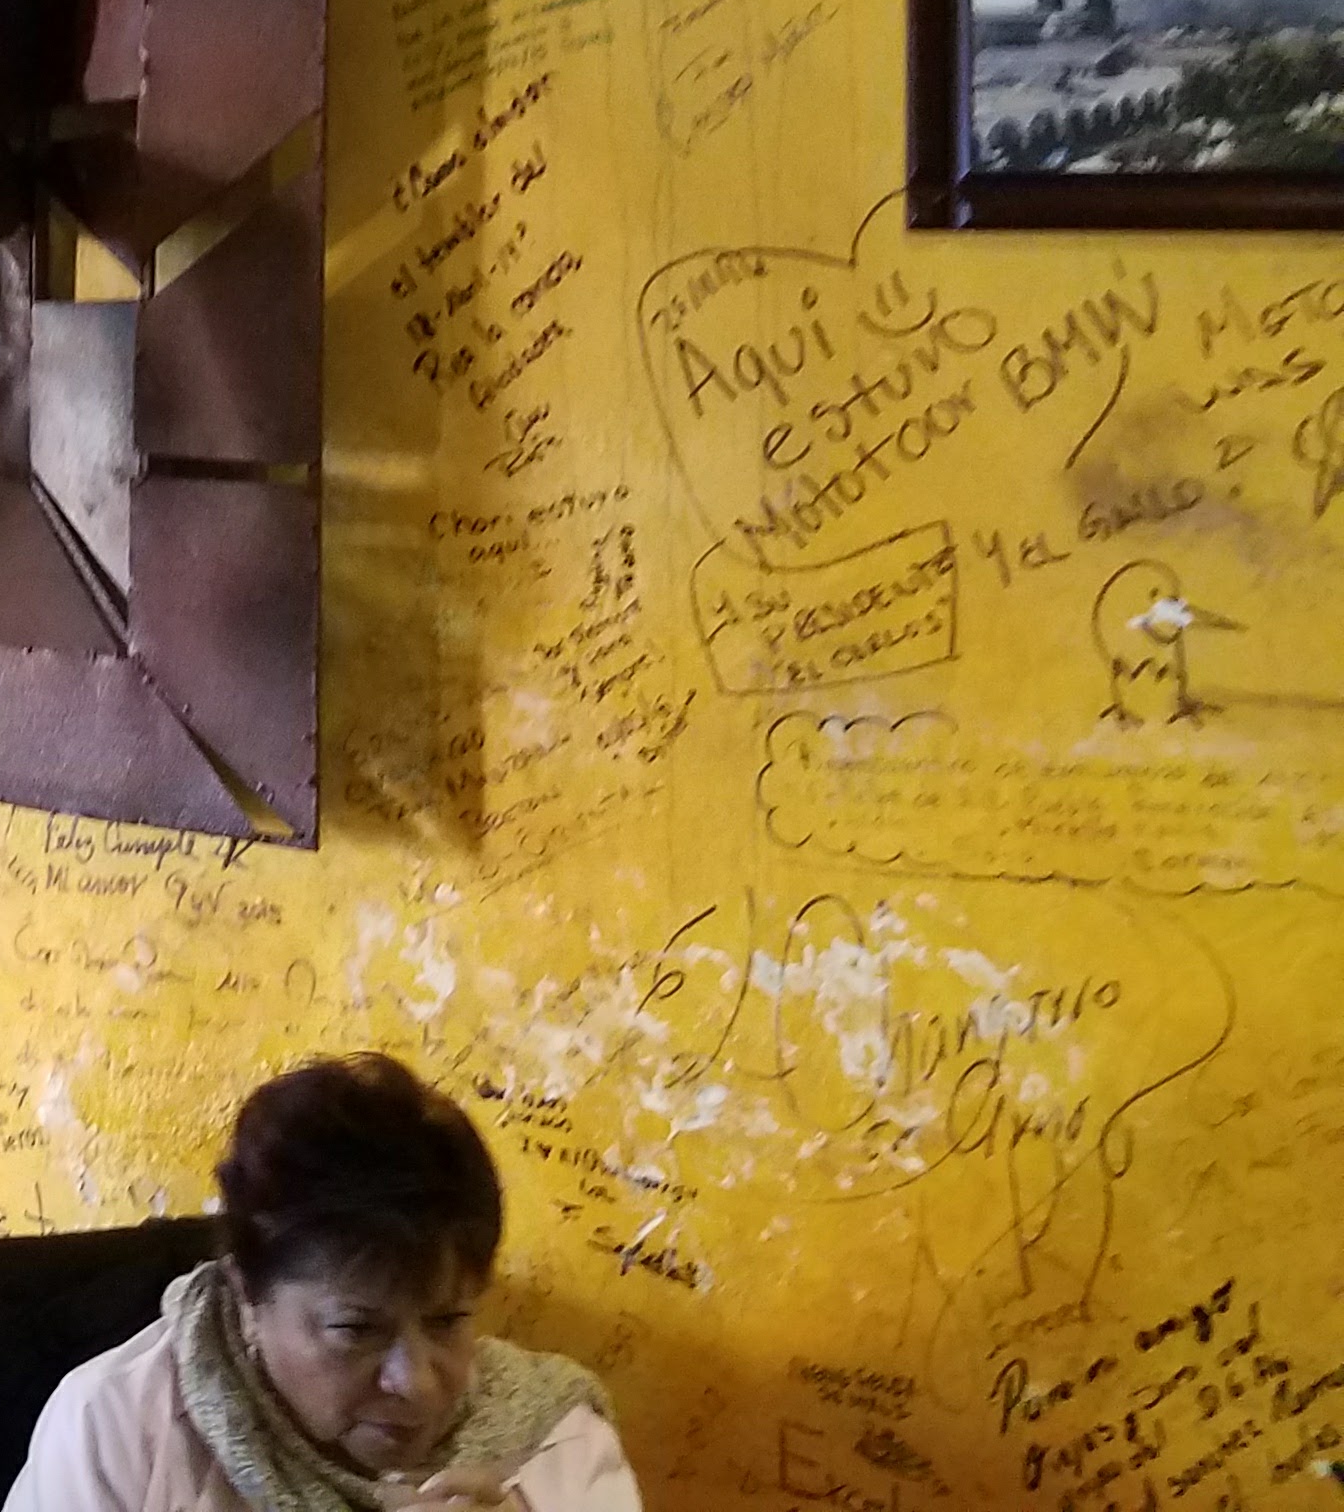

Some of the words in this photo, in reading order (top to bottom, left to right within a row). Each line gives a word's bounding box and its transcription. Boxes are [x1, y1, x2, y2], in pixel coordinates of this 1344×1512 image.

[674, 286, 837, 419] Aqui
[762, 306, 999, 470] estuvo
[999, 271, 1162, 415] BMW
